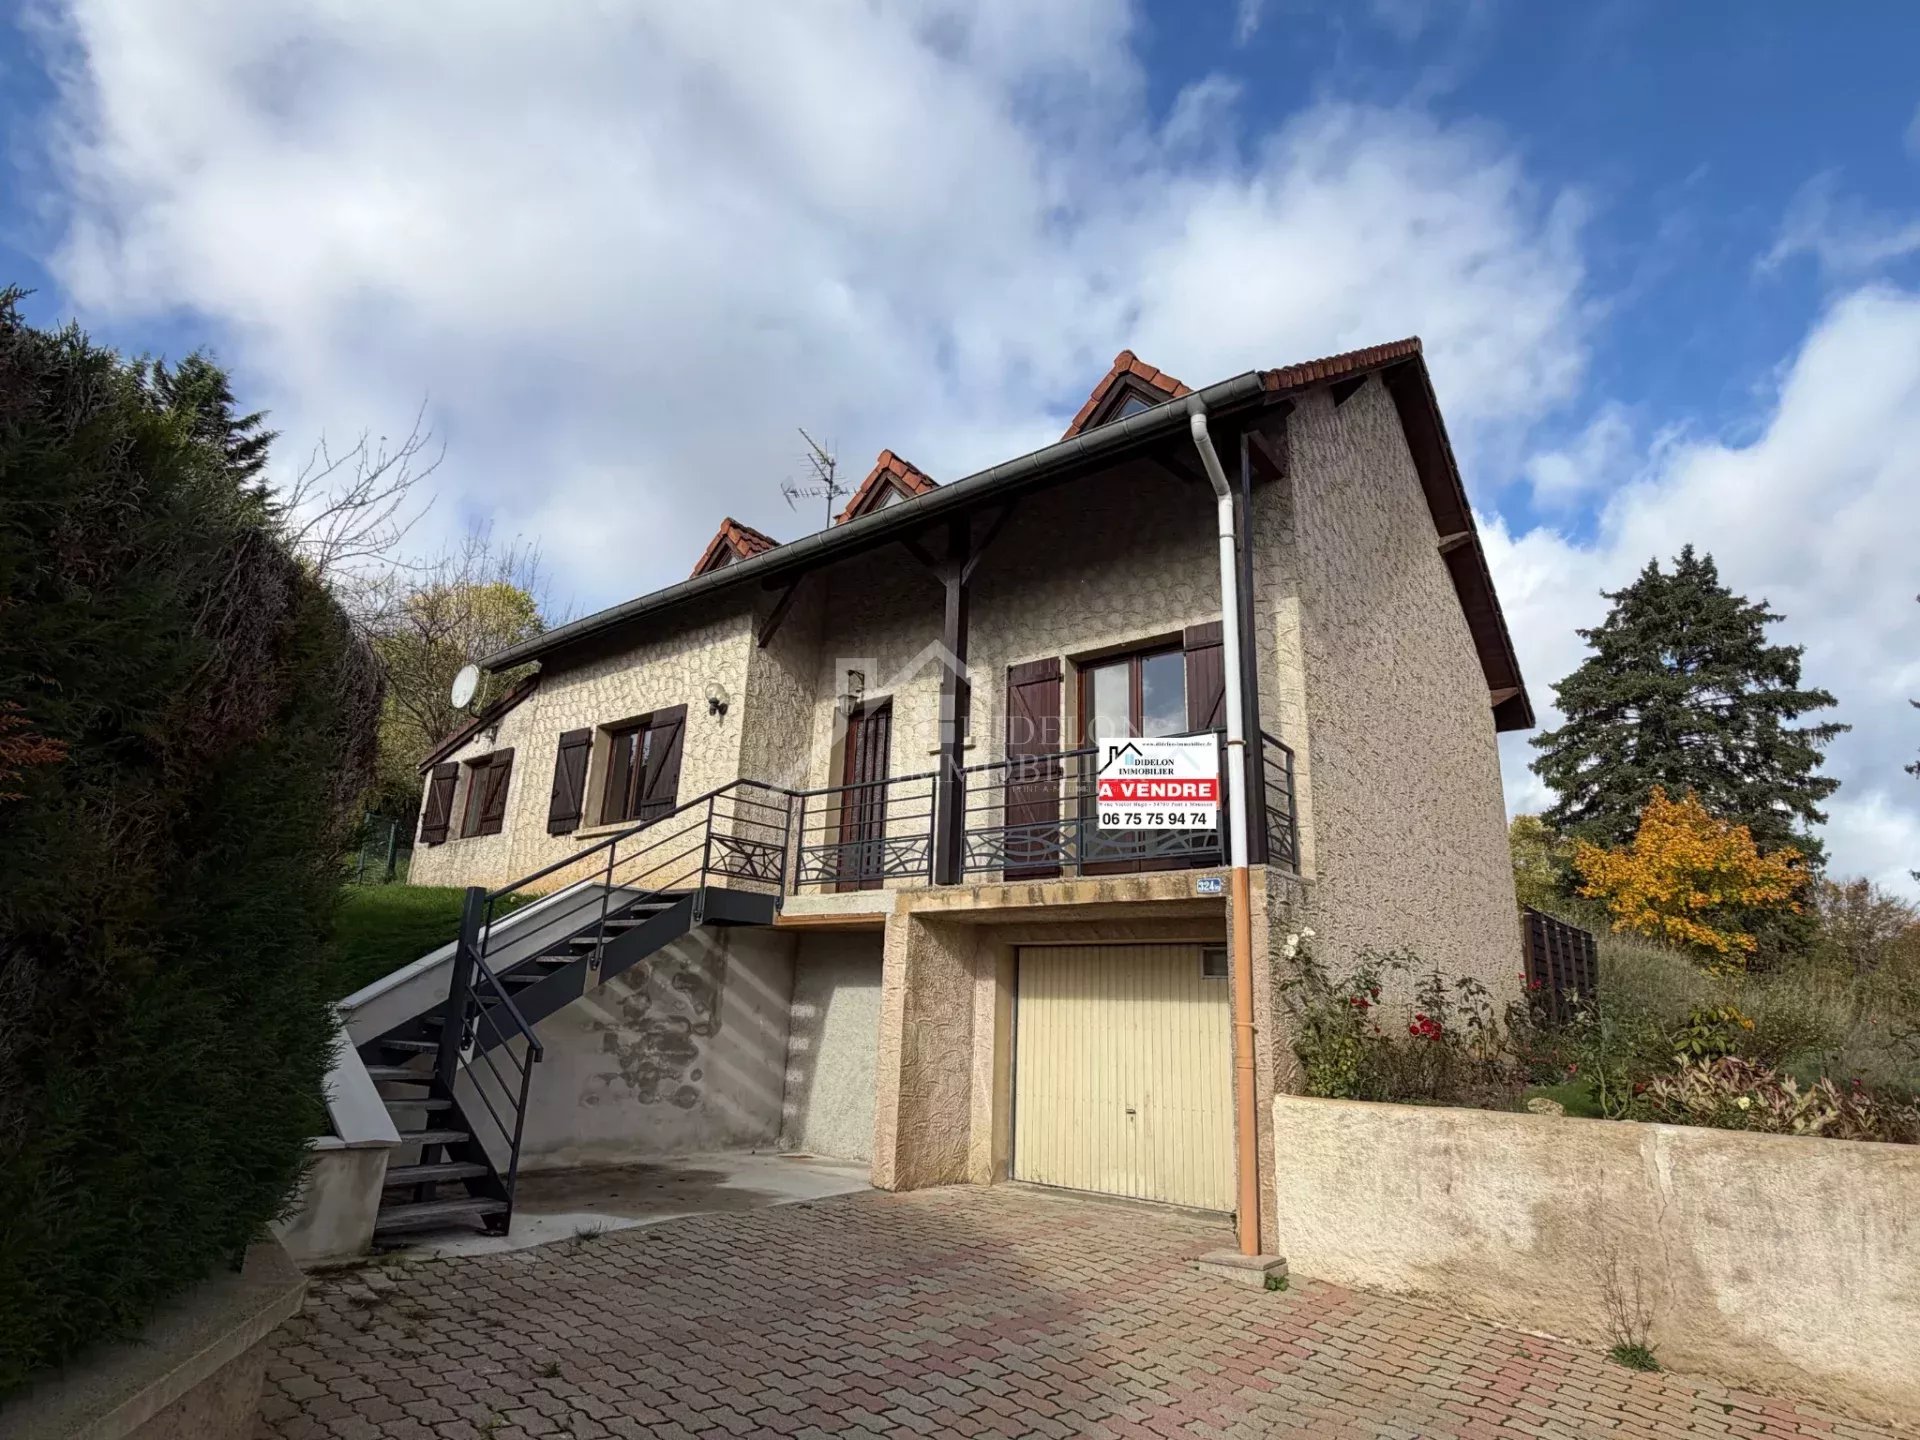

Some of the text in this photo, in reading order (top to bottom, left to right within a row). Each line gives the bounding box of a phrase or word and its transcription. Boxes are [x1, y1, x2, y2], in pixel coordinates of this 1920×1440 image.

[1099, 783, 1113, 797] A
[1120, 783, 1212, 797] VENDRE
[1102, 813, 1207, 825] 06 75 75 94 74
